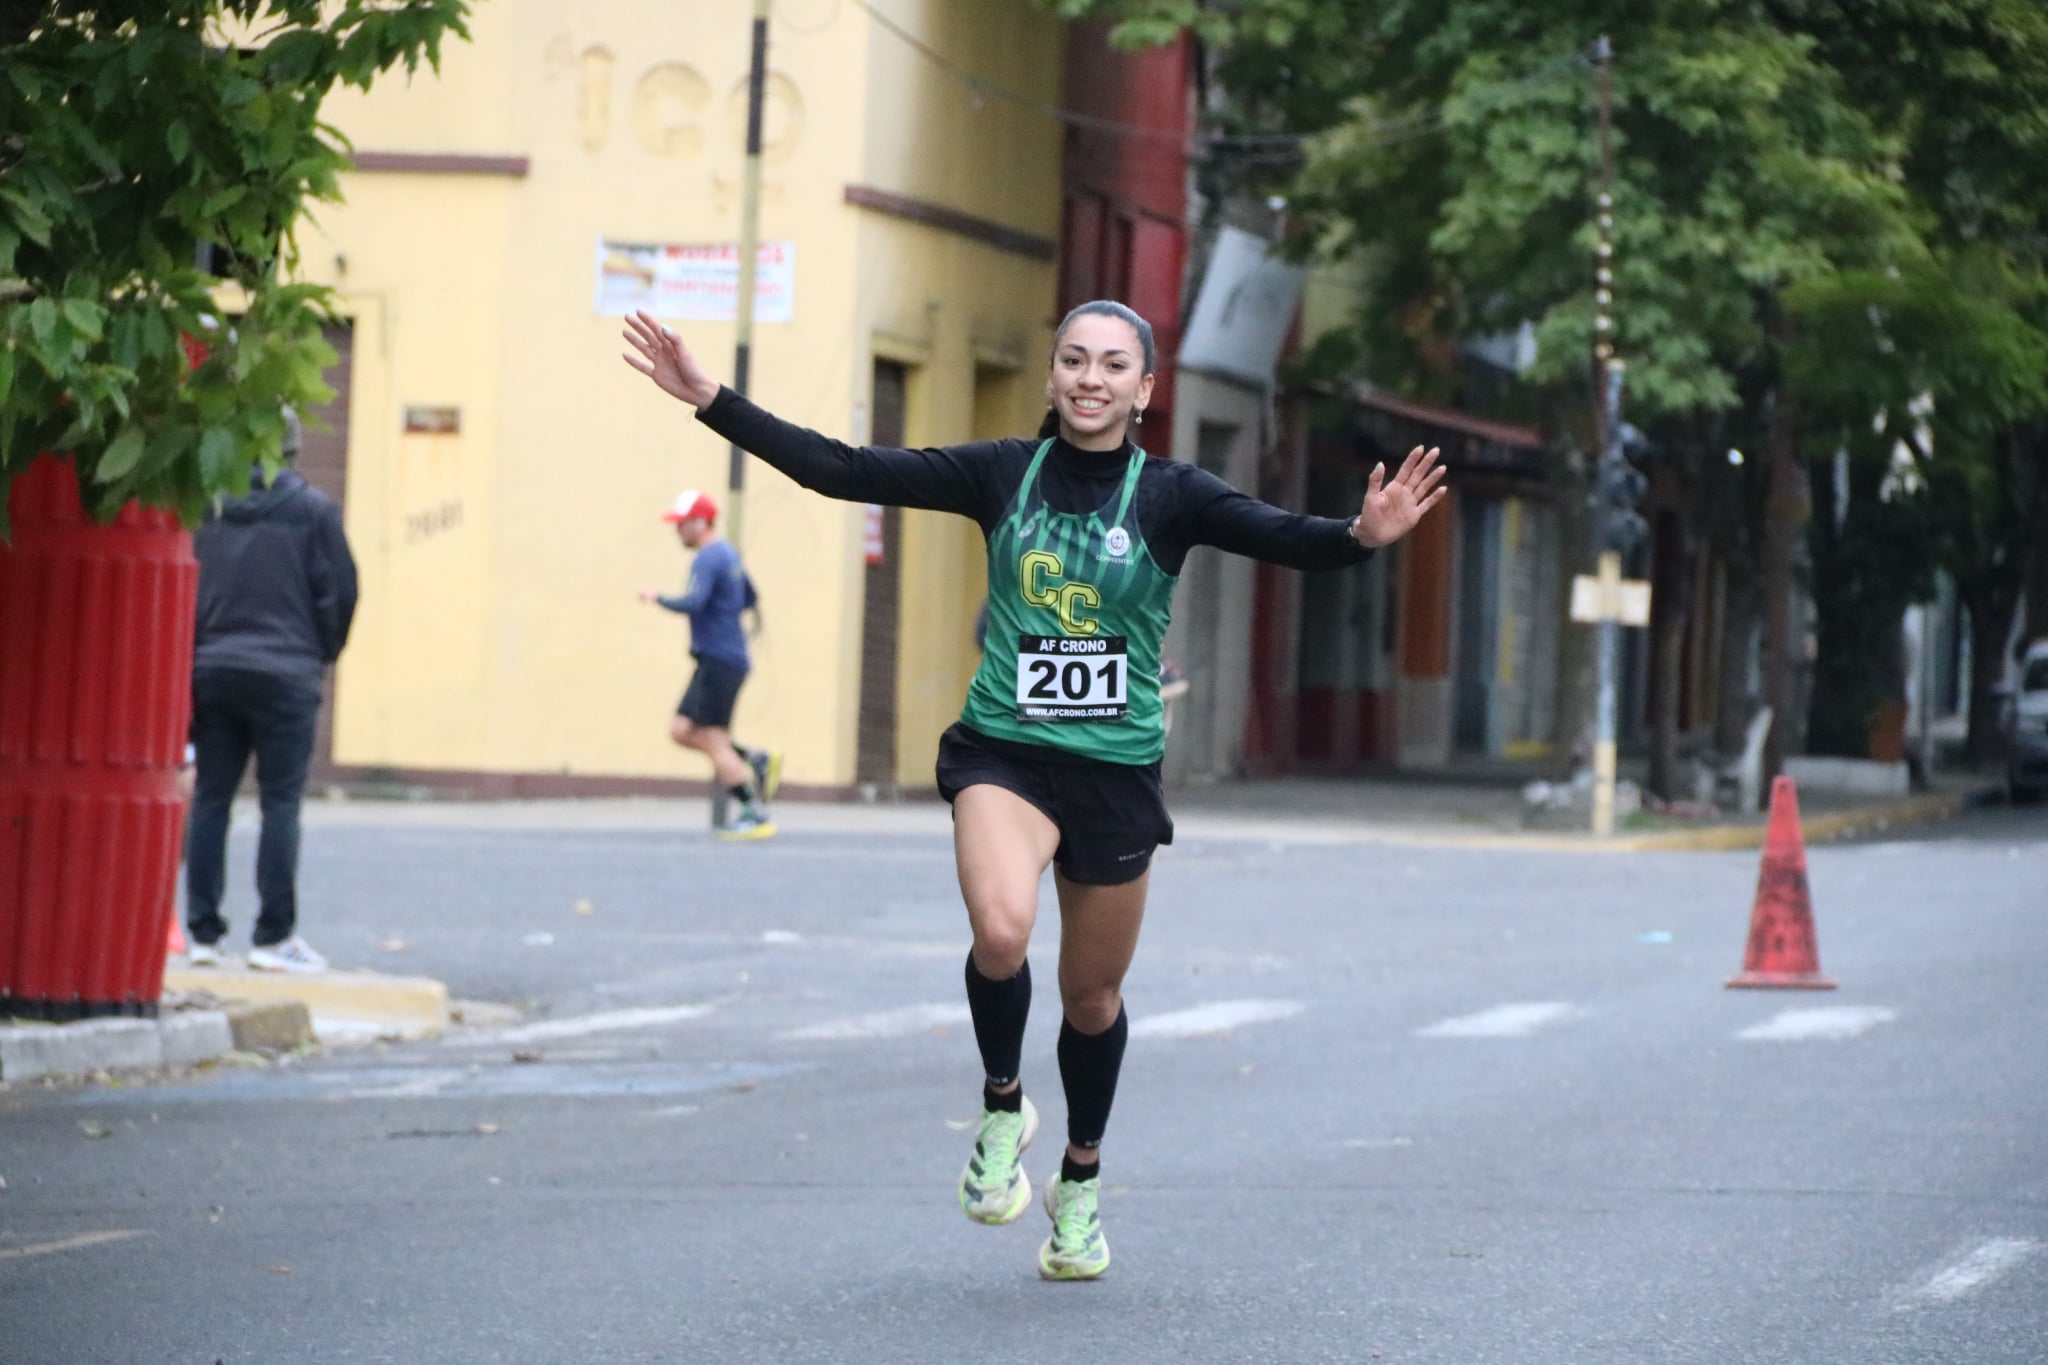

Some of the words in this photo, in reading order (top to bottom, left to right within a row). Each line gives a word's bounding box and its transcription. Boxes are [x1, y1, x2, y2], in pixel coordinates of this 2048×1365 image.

[1039, 639, 1057, 652] AF
[1060, 640, 1107, 653] CRONO
[1027, 659, 1118, 701] 201
[1026, 707, 1118, 718] WWW.AFCRONO.COM.BR
